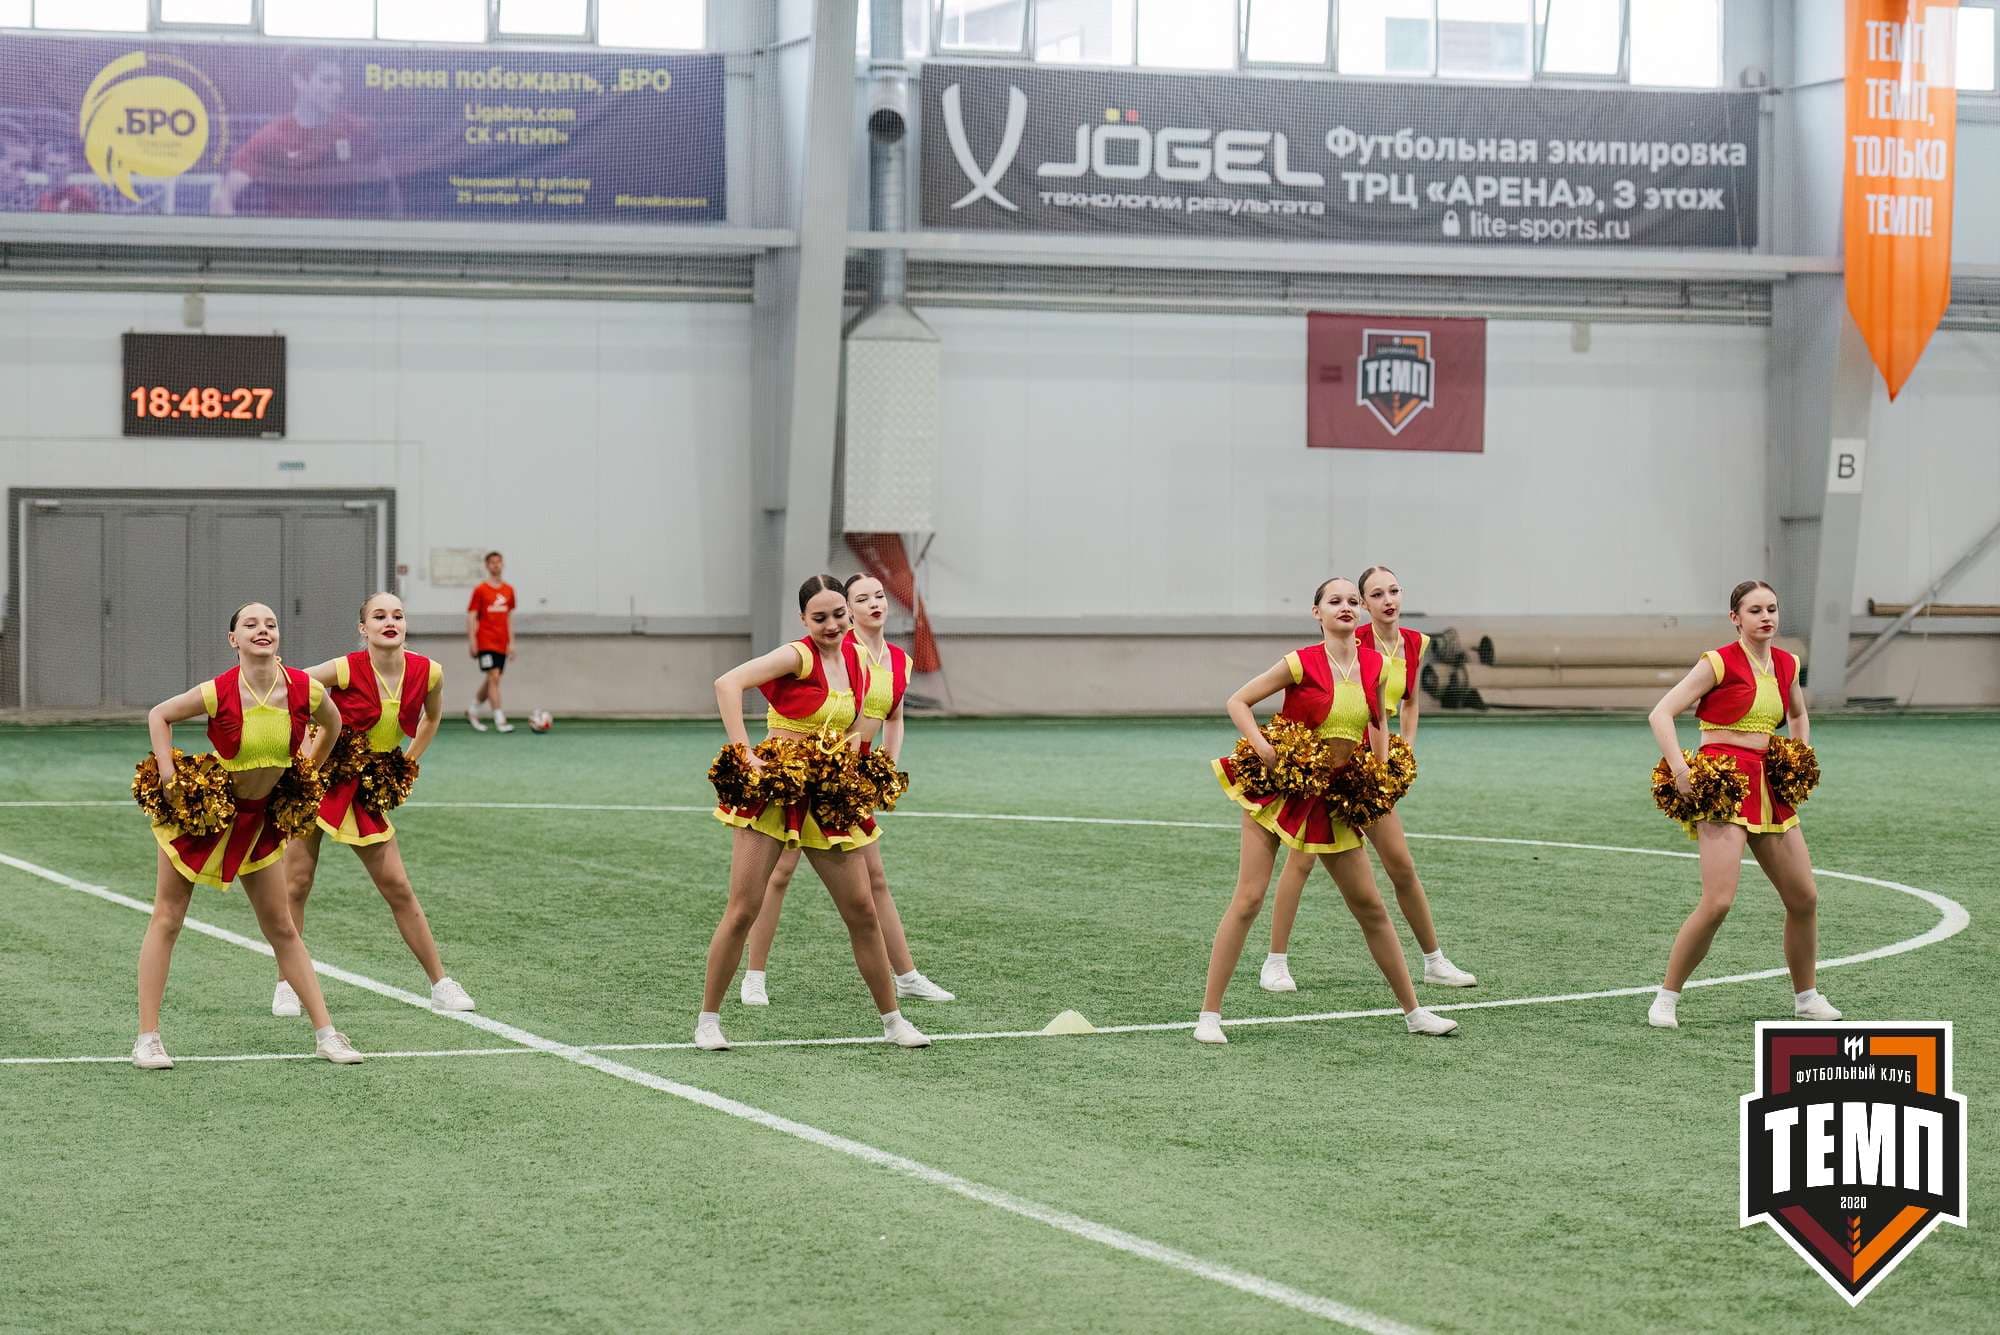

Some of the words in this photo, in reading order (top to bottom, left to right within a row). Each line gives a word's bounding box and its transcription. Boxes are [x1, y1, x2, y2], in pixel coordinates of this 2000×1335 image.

[365, 63, 447, 91] Время
[456, 66, 604, 95] побеждать,
[612, 68, 672, 93] .БРО
[464, 103, 577, 123] Ligabro.com
[1865, 78, 1935, 127] ТЕМП,
[117, 108, 197, 137] .БРО
[464, 126, 490, 145] СК
[496, 127, 569, 145] «ТЕМП»
[1037, 107, 1326, 187] JÖGEL
[1325, 126, 1538, 165] Футбольная
[1548, 139, 1748, 172] экипировка
[1851, 135, 1948, 181] ТОЛЬКО
[1039, 191, 1182, 210] технологии
[1187, 195, 1326, 216] результата
[1341, 172, 1419, 210] ТРЦ
[1426, 175, 1605, 213] «АРЕНА»,
[1612, 180, 1637, 209] 3
[1643, 186, 1726, 211] этаж
[1469, 214, 1631, 243] lite-sports.ru
[1865, 193, 1934, 238] ТЕМП!
[1365, 359, 1428, 397] ТЕМП
[131, 385, 274, 420] 18:48:27
